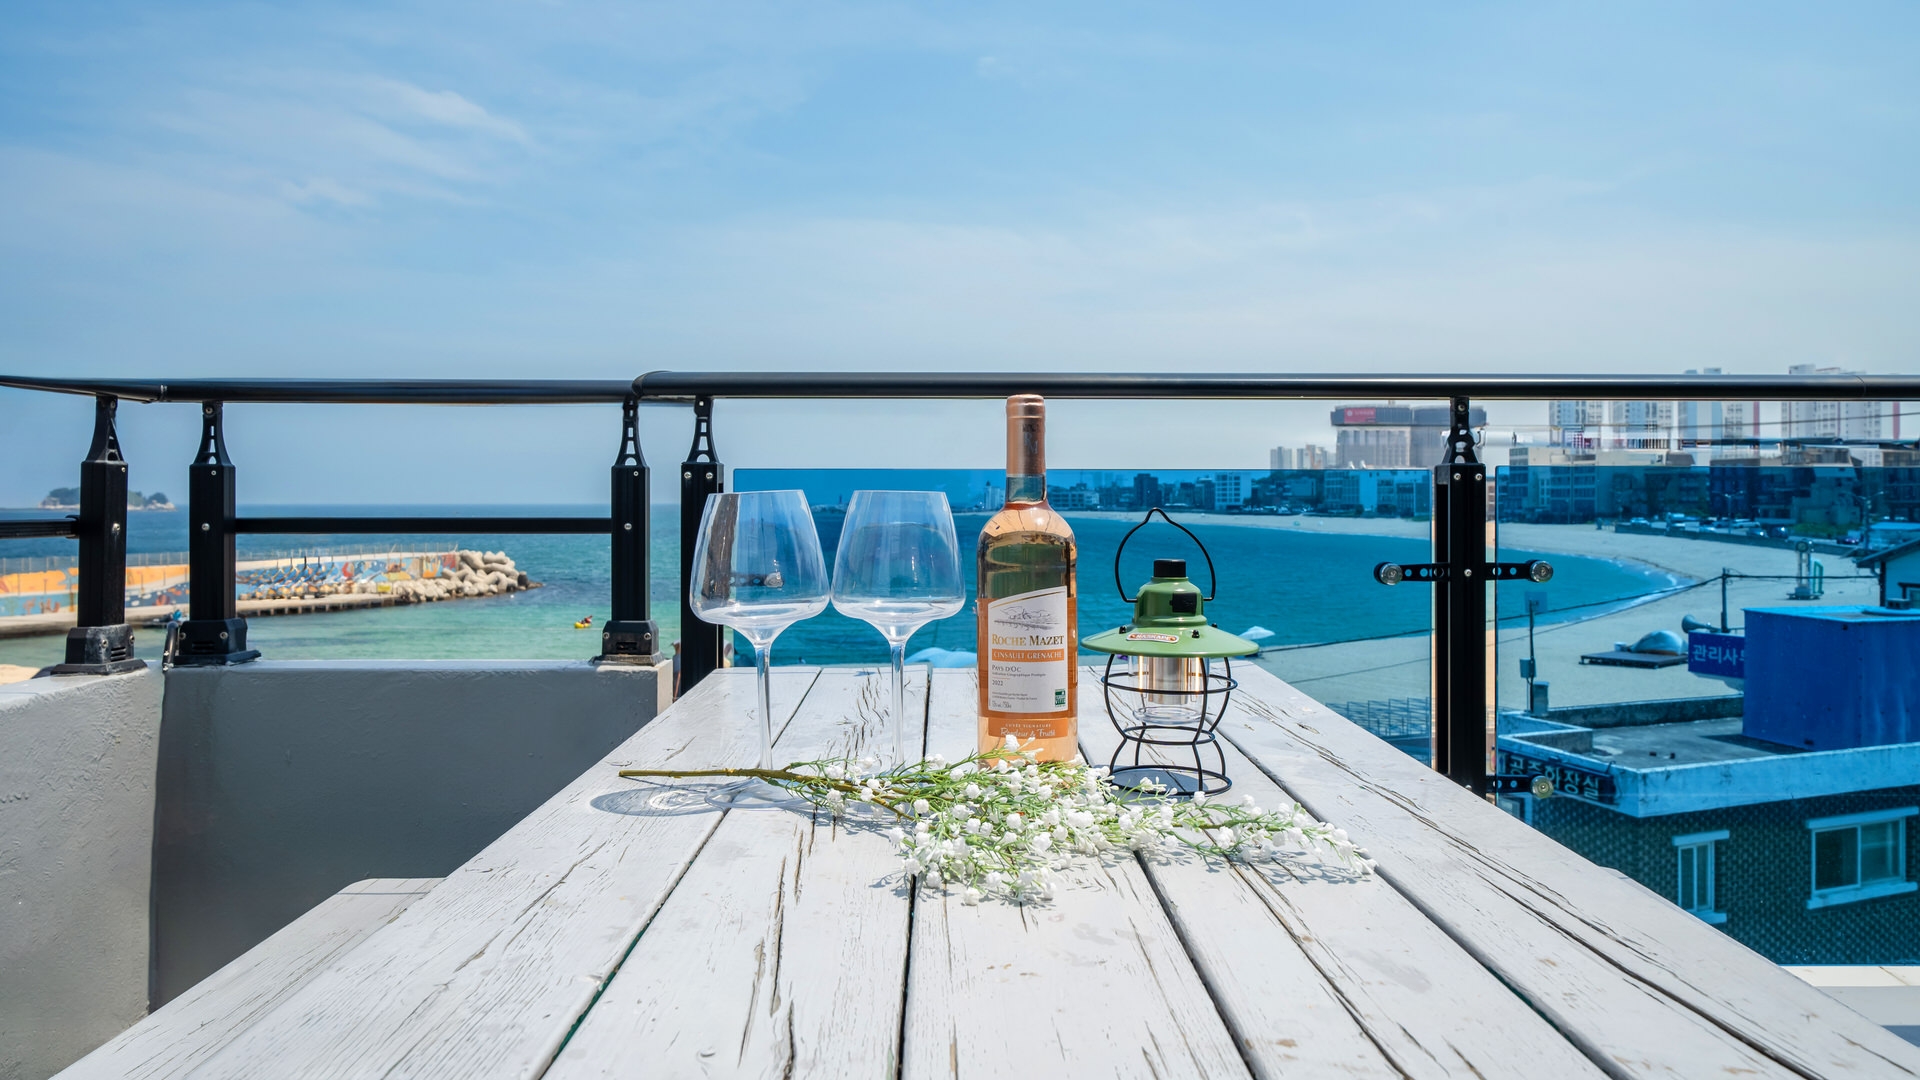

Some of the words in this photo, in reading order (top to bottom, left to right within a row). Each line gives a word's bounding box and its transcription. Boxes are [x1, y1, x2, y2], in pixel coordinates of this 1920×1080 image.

[992, 634, 1027, 646] ROCHE
[1029, 635, 1064, 646] MAZET
[993, 651, 1025, 659] CINSAULT
[1027, 651, 1063, 659] GRENACHE
